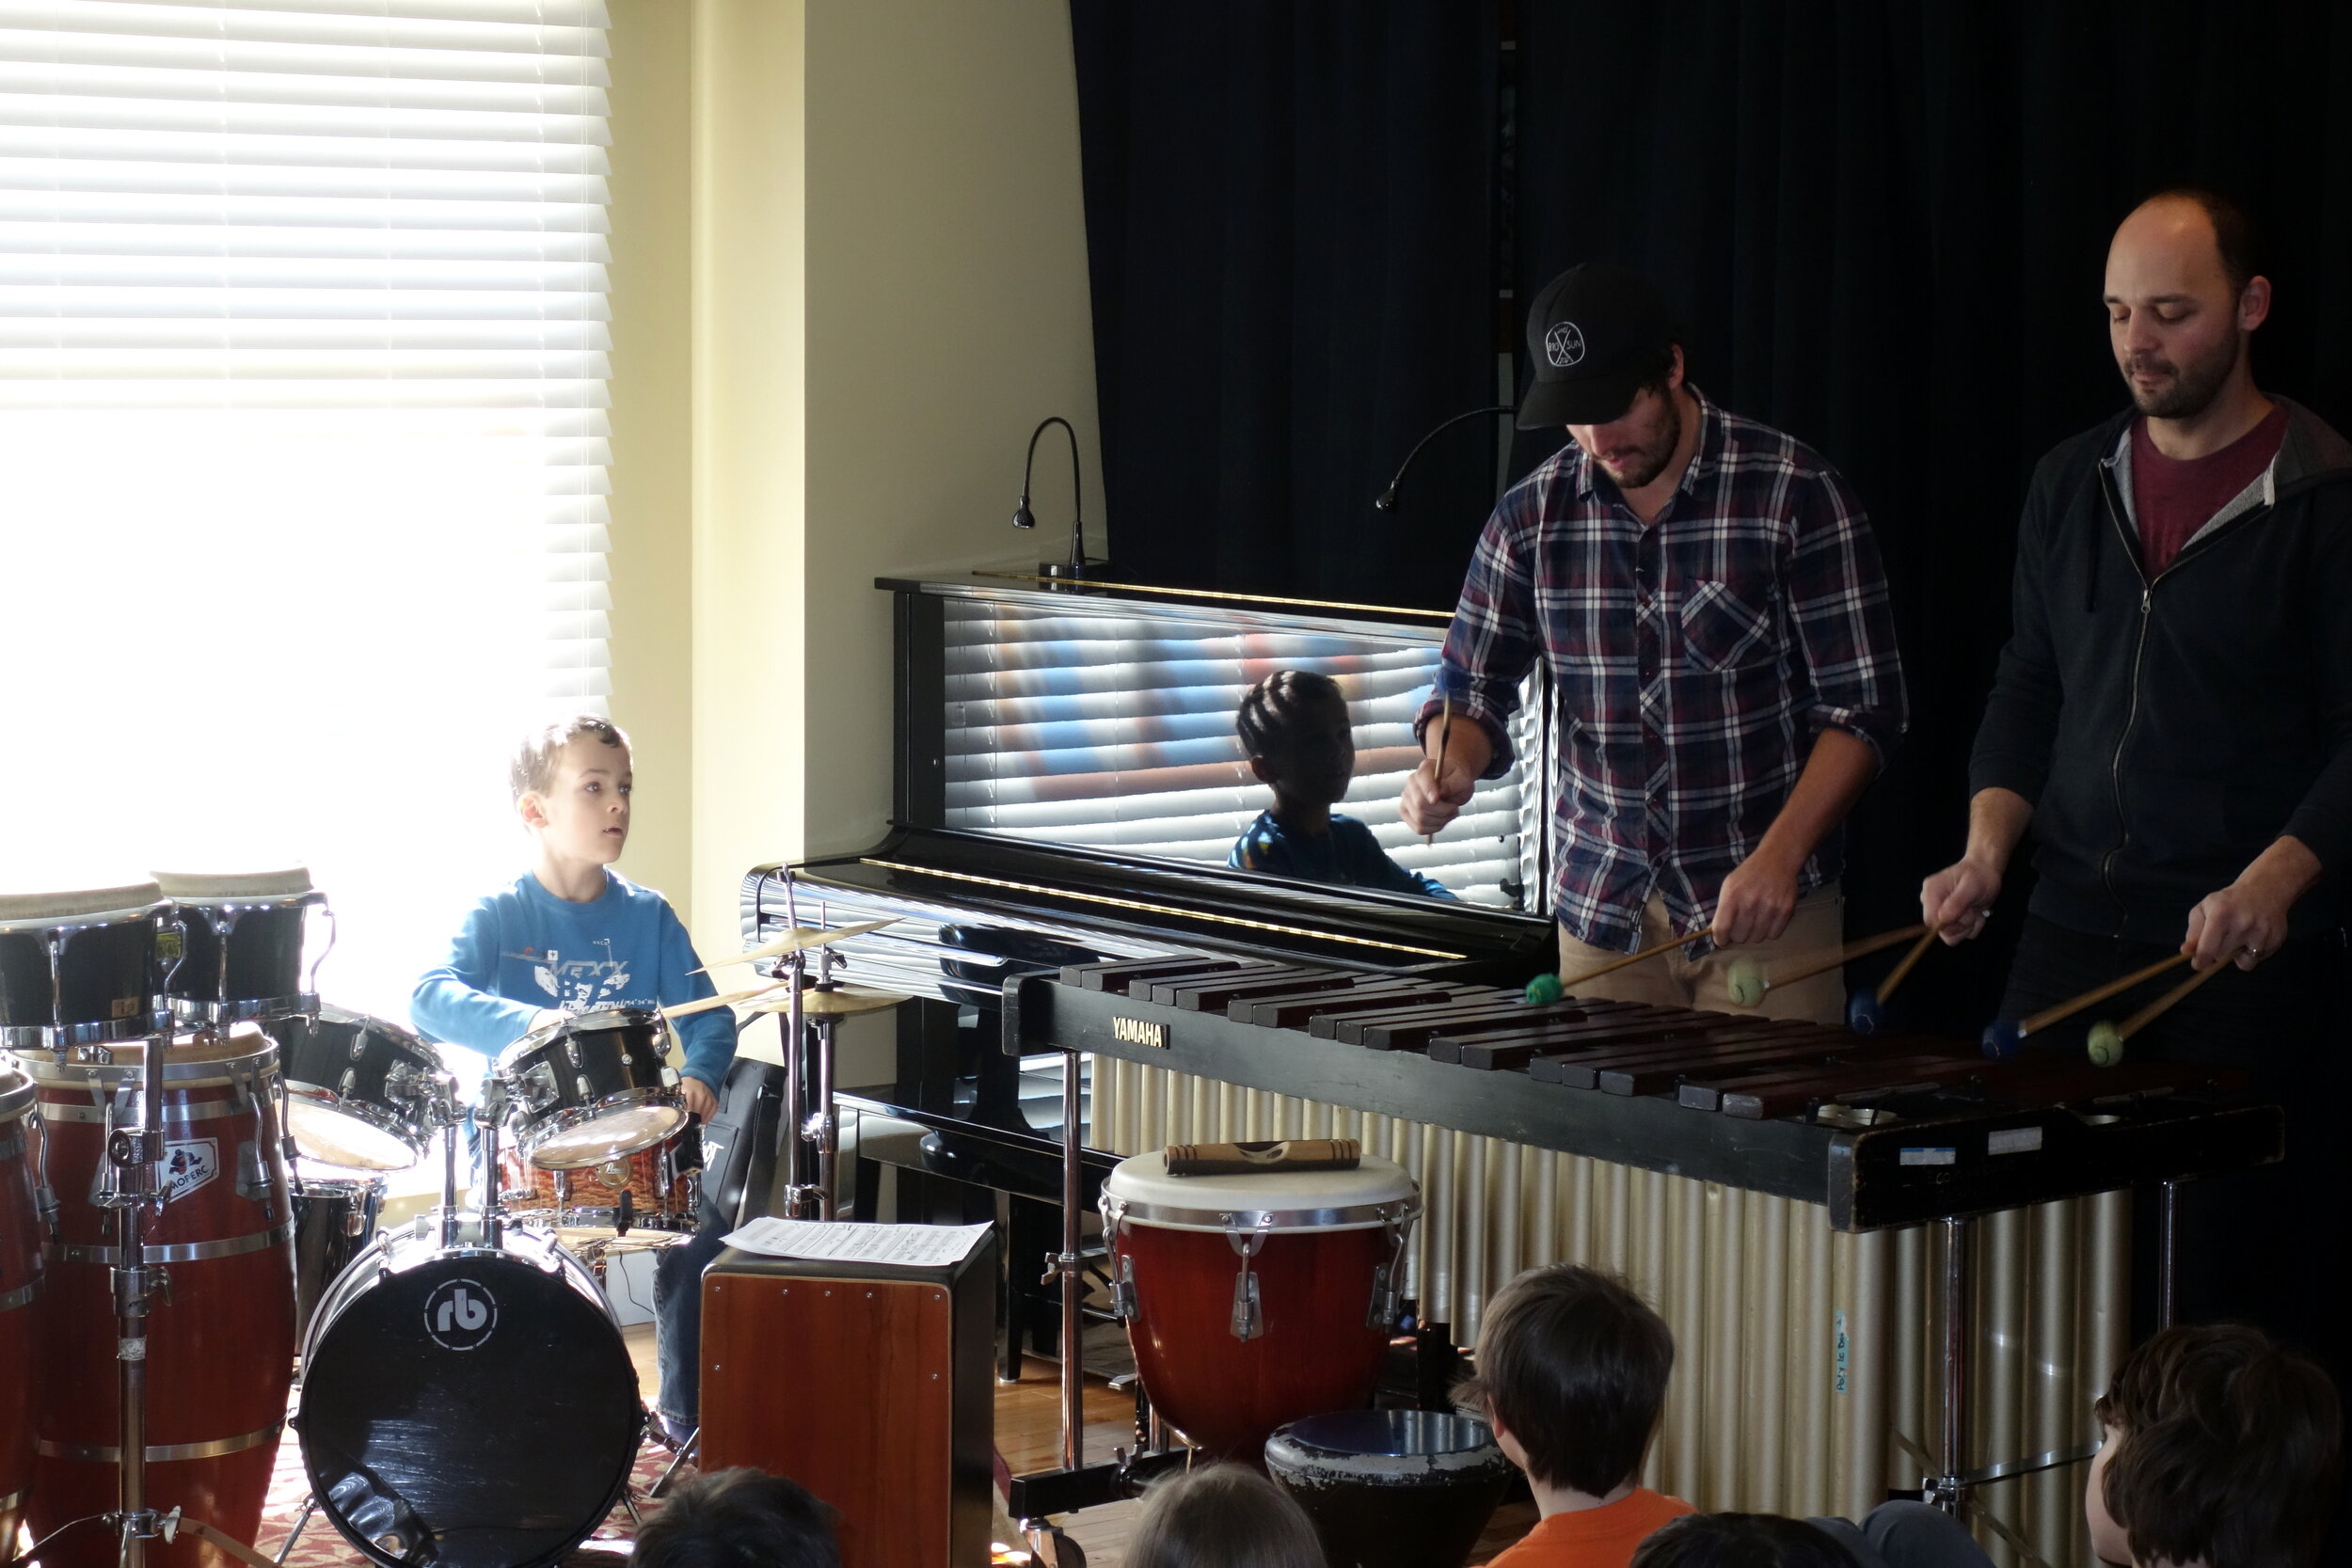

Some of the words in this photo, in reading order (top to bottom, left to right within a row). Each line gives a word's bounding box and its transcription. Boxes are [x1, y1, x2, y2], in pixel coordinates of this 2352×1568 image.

[1566, 340, 1581, 350] SUN
[1112, 1016, 1163, 1048] YAMAHA
[170, 1164, 210, 1191] MOPERC
[437, 1288, 487, 1332] rb
